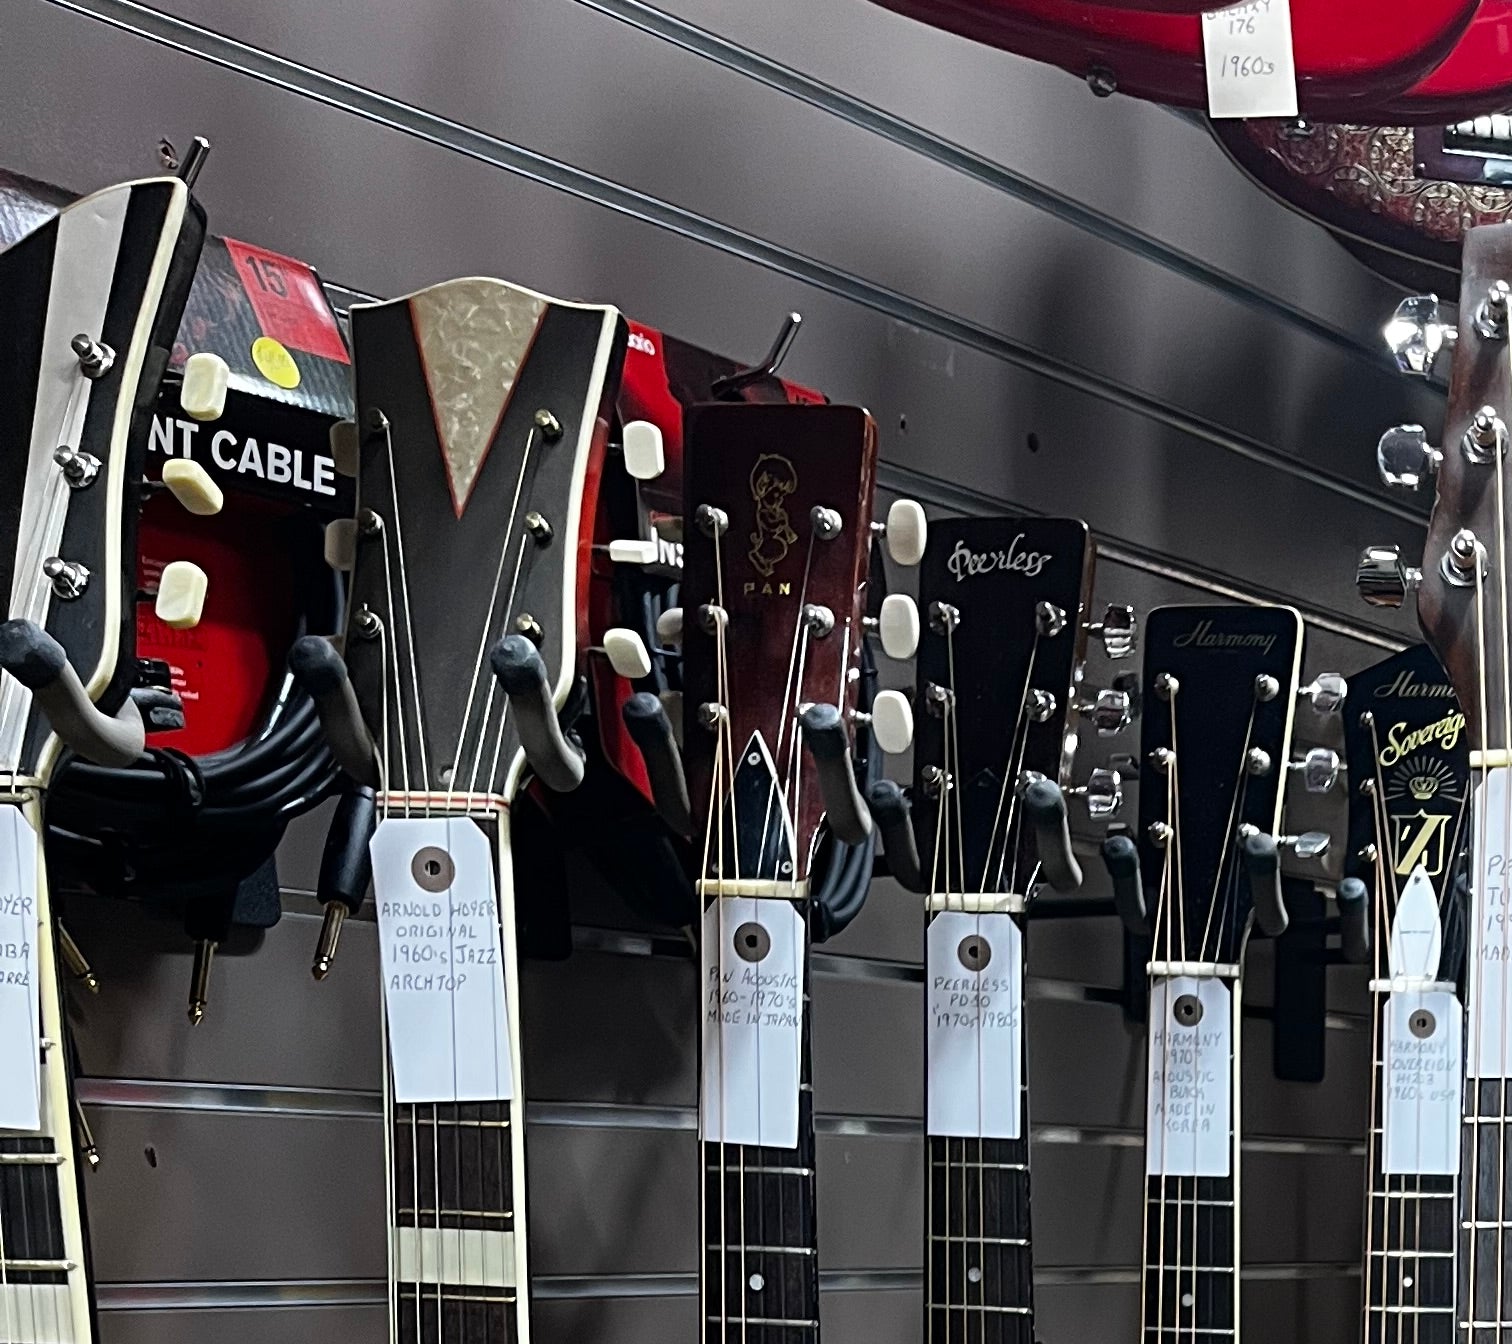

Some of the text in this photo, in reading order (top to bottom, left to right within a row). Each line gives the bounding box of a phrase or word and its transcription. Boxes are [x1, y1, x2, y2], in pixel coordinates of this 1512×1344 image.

[1229, 16, 1256, 35] 176
[148, 413, 336, 496] NT CABLE
[947, 533, 1053, 582] Peerless
[743, 582, 791, 596] PAN
[1173, 619, 1277, 656] Harmony
[1379, 708, 1466, 767] Sovereig
[0, 893, 33, 916] YER
[381, 899, 496, 918] ARNOLD HOYER
[396, 924, 478, 939] ORIGINAL
[934, 975, 1009, 993] PEERLESS
[1153, 1070, 1215, 1084] AOUSTIC
